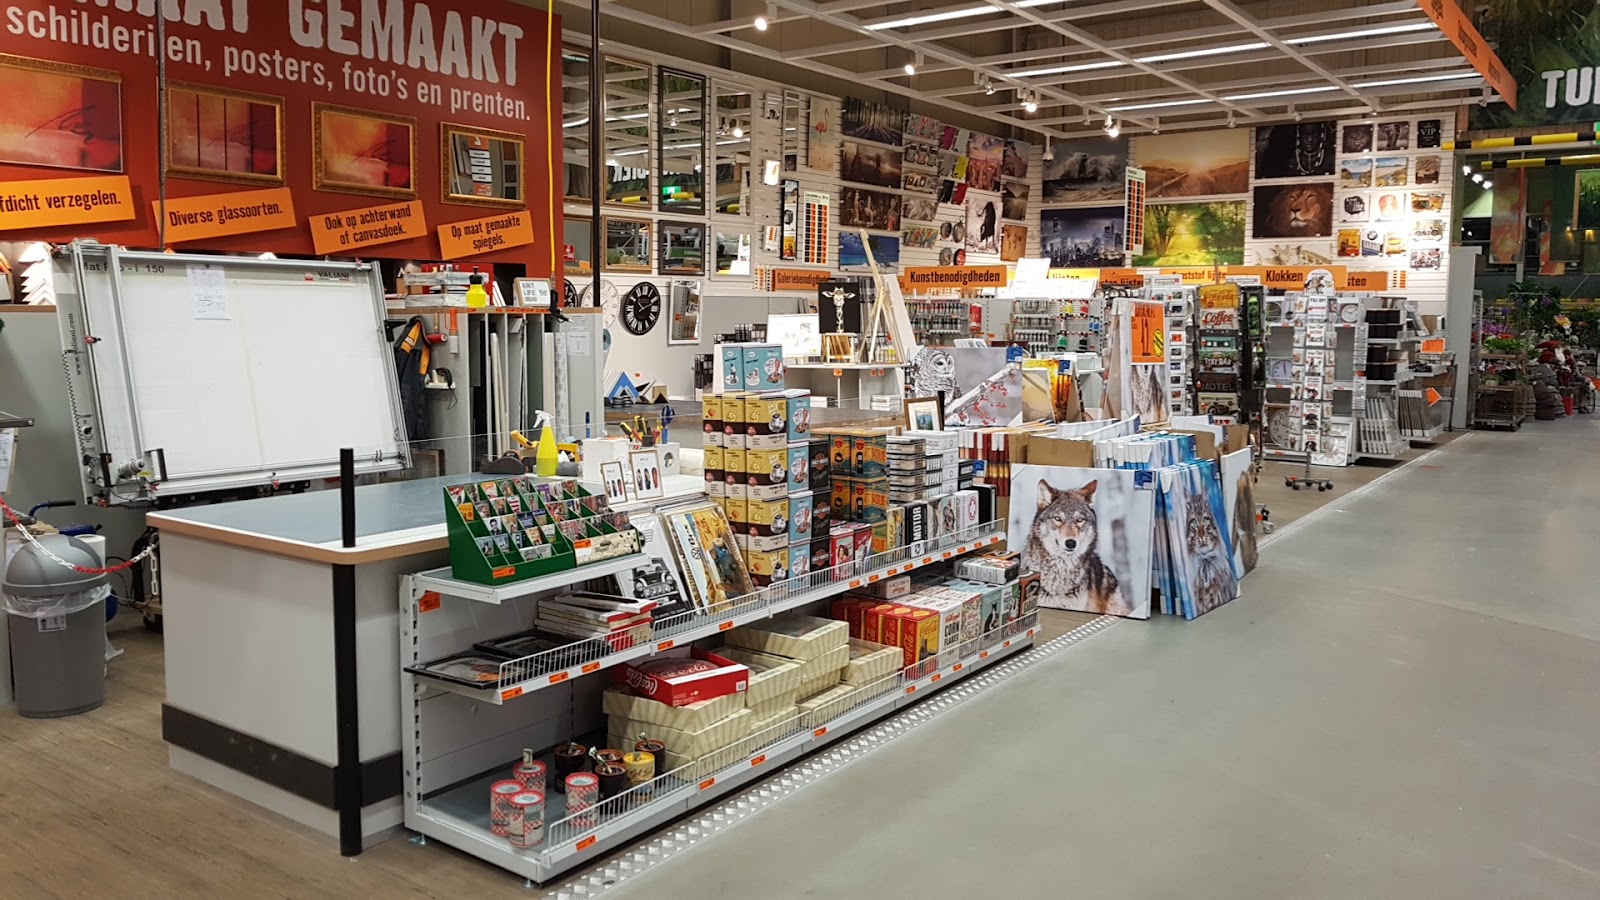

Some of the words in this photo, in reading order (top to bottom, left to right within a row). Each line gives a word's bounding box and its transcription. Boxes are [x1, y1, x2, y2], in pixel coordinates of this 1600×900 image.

[289, 0, 523, 86] GEMAAKT
[6, 5, 211, 71] schilderien,
[224, 45, 333, 92] posters,
[342, 61, 408, 99] foto's
[417, 81, 441, 105] en
[450, 87, 531, 121] prenten.
[1420, 128, 1437, 136] VIP
[45, 190, 121, 210] verzegelen.
[169, 209, 213, 227] Diverse
[217, 203, 283, 224] glassoorten.
[325, 216, 343, 230] Ook
[347, 215, 357, 230] op
[360, 206, 411, 225] achterwand
[340, 231, 350, 245] of
[353, 224, 407, 243] canvasdoek.
[451, 225, 462, 240] Op
[464, 221, 483, 235] maat
[486, 216, 521, 234] gemaakte
[472, 234, 506, 251] spiegels.
[145, 265, 165, 273] 150
[910, 270, 1000, 285] Kunstbenodigdheden
[1266, 270, 1304, 282] Klokken
[1204, 310, 1234, 325] Coffee
[1203, 382, 1235, 391] MOTEL
[913, 506, 922, 540] MOTOR
